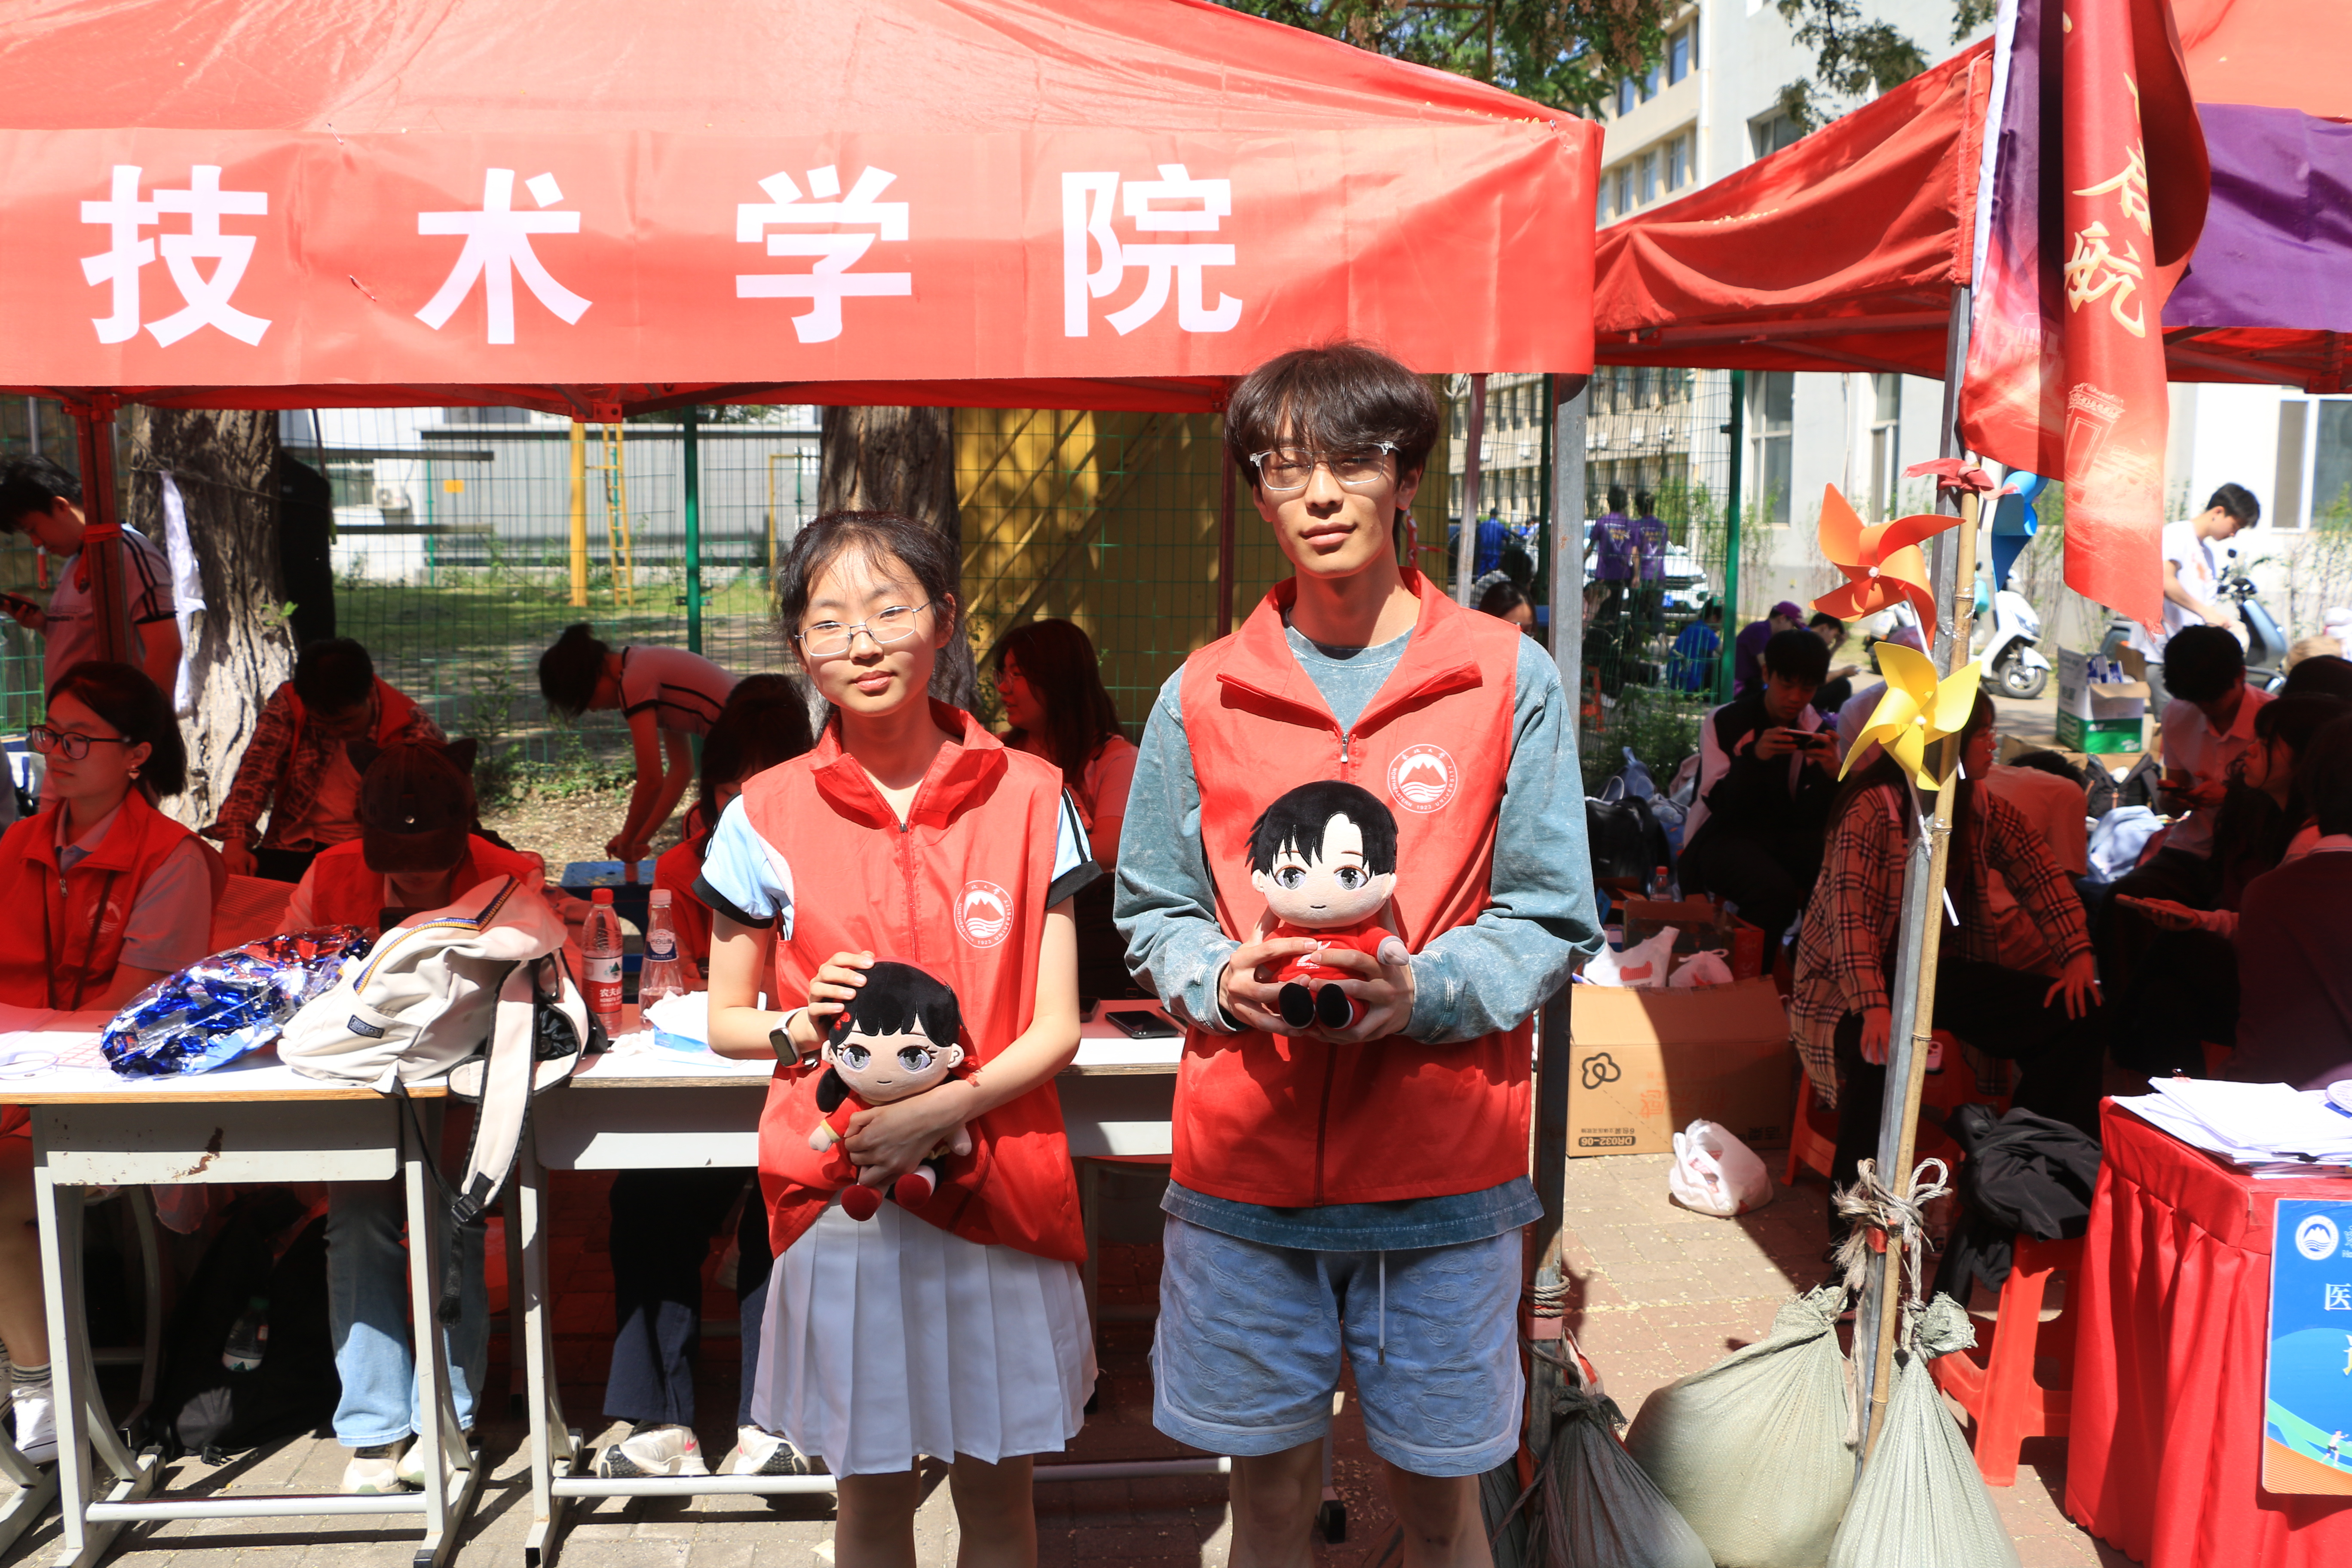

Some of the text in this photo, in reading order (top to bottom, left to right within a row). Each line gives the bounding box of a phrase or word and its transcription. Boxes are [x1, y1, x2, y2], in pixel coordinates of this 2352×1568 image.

[80, 164, 1243, 348] 技术学院
[1391, 768, 1412, 807] NORTHEASTERN
[1436, 766, 1455, 806] UNIVERSITY
[994, 900, 1011, 940] UNIVERSITY
[1581, 1137, 1633, 1146] DR032-06
[2324, 1283, 2352, 1311] 医
